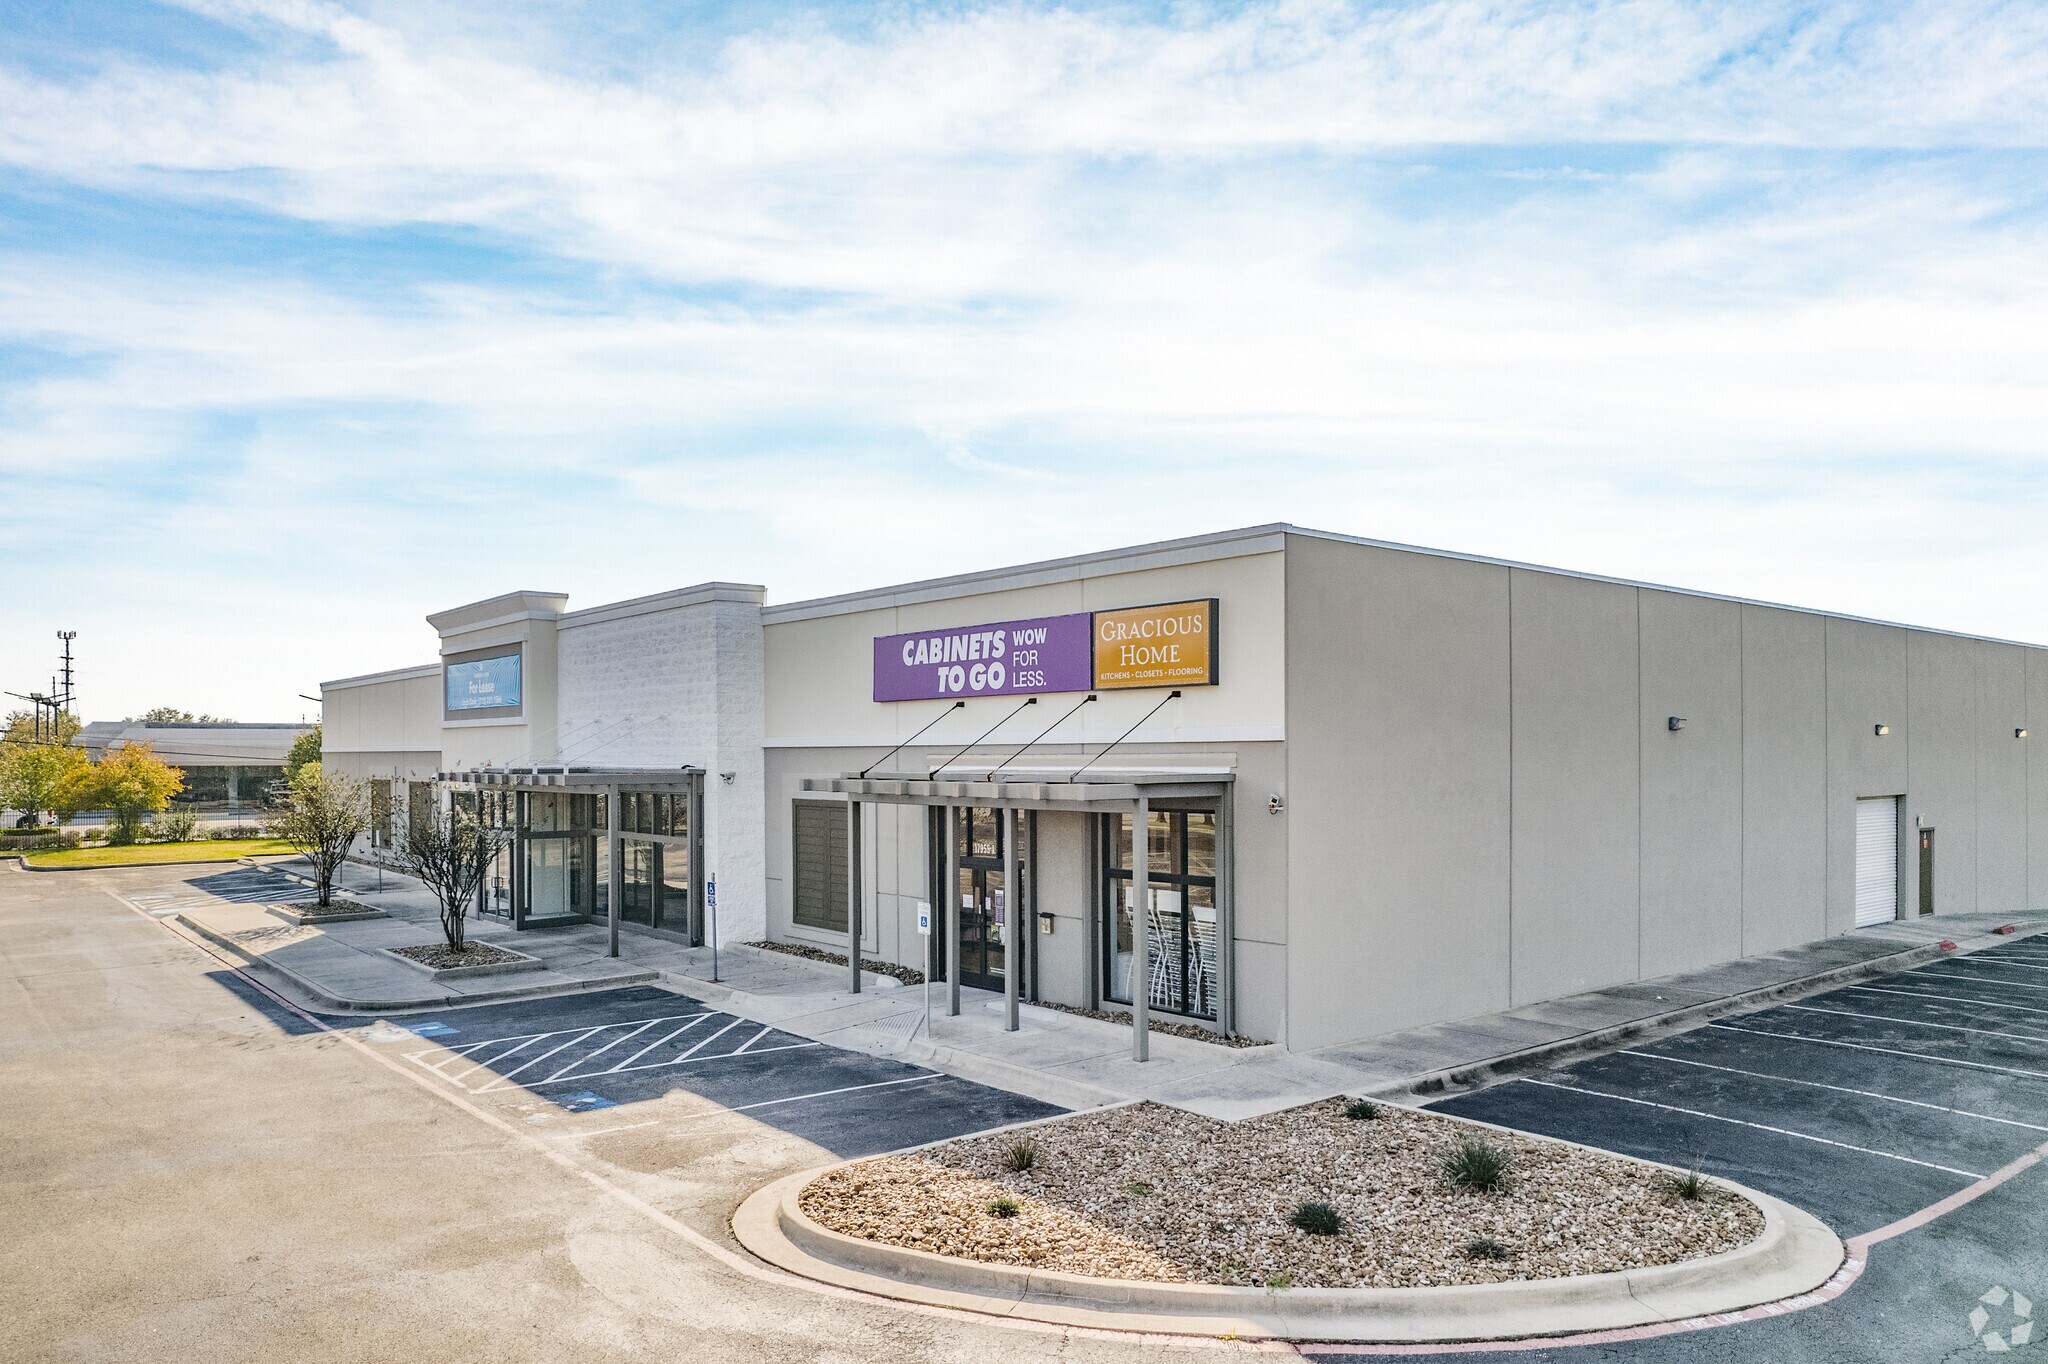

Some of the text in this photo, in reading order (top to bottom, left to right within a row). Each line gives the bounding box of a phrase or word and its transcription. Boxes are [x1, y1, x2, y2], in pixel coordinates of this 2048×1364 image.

[1101, 614, 1202, 641] GRACIOUS
[1013, 628, 1047, 646] WOW
[902, 630, 1006, 666] CABINETS
[1120, 644, 1180, 666] HOME
[1013, 650, 1038, 667] FOR
[938, 661, 1006, 693] TO GO
[1013, 670, 1047, 688] LESS.
[1100, 667, 1203, 680] KITCHENS CLOSETS FLOORING
[469, 680, 495, 694] For Lease
